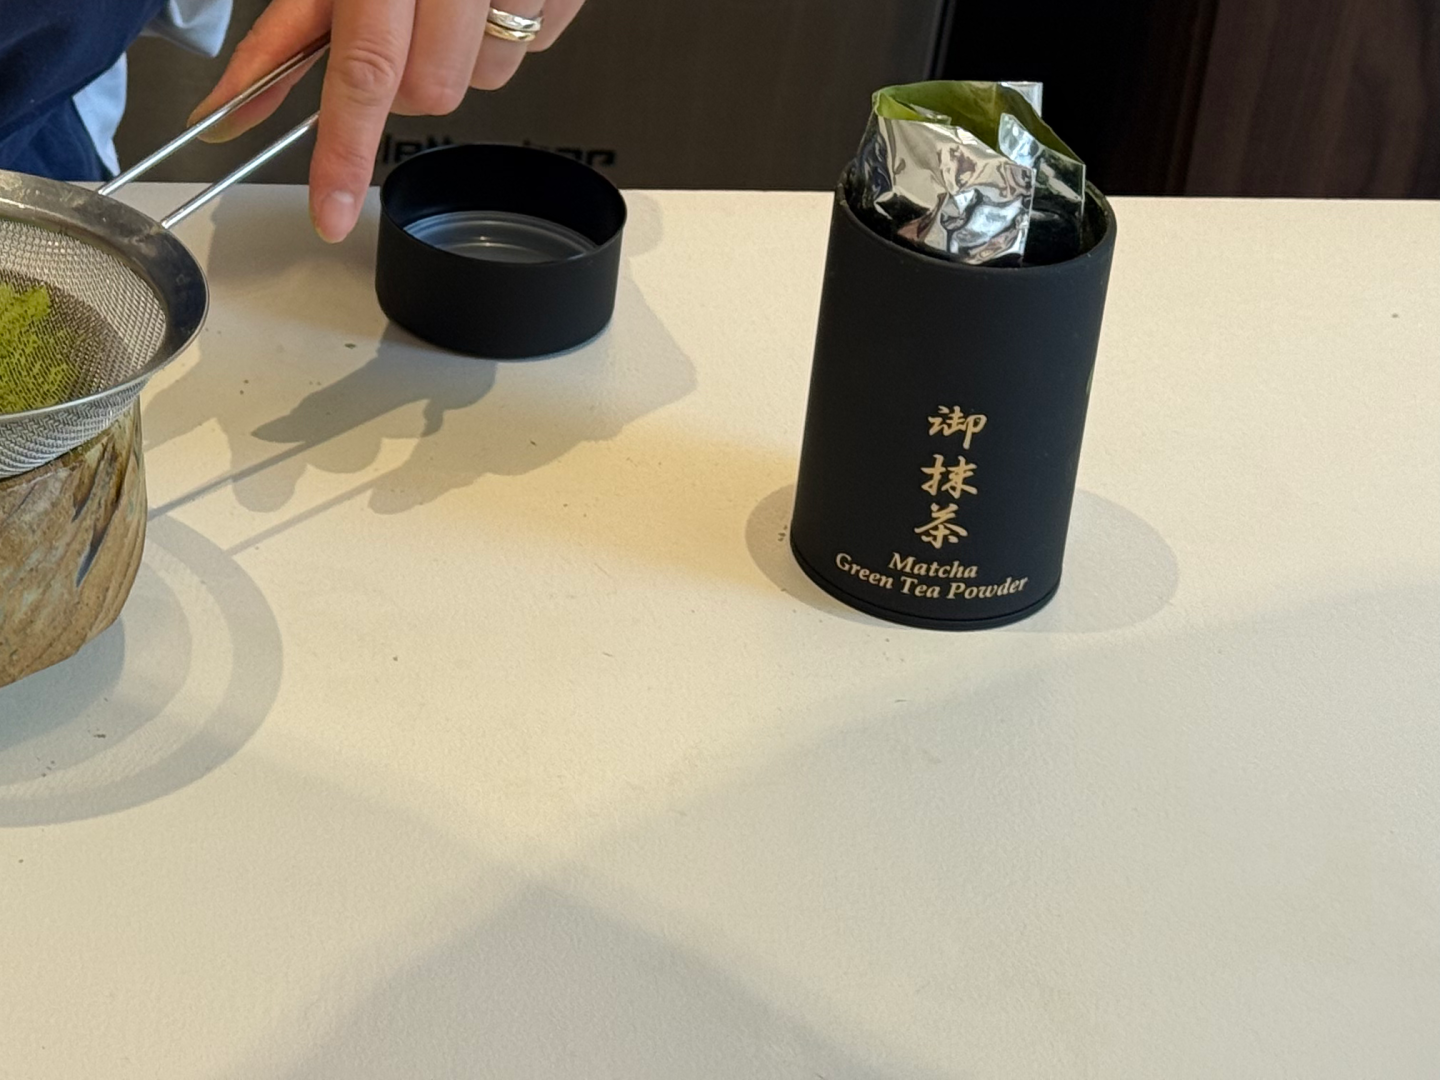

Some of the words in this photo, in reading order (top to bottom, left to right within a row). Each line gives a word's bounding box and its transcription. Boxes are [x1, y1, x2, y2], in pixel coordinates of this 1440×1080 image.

[914, 405, 987, 549] 御抹茶
[835, 552, 894, 590] Green
[900, 576, 940, 598] Tea
[946, 576, 1029, 599] Powder
[888, 552, 978, 578] Matcha
